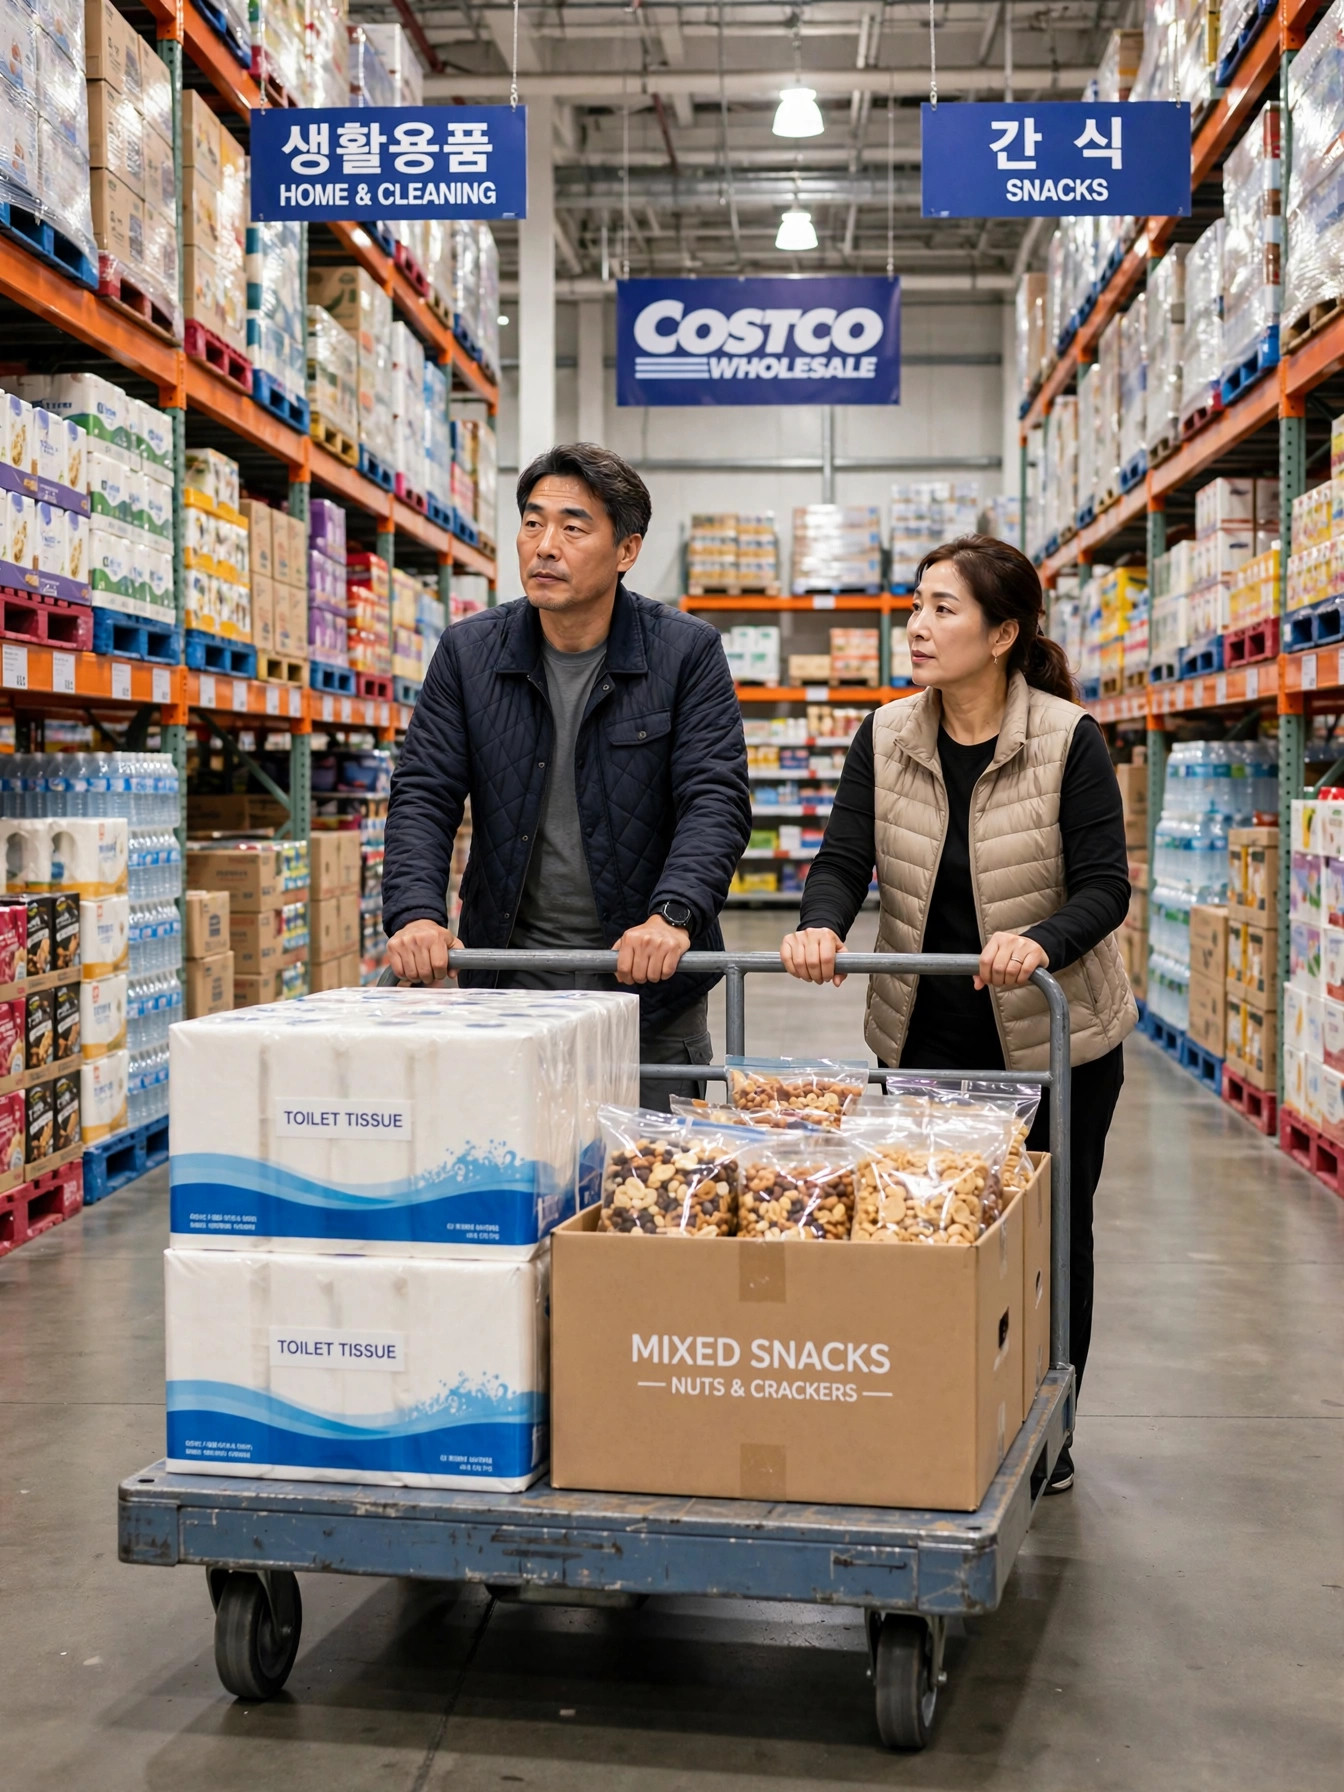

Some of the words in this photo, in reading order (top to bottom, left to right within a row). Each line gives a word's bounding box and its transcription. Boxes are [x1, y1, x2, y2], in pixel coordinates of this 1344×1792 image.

[281, 121, 493, 176] 생활용품
[280, 183, 349, 207] HOME
[356, 183, 372, 206] &
[377, 181, 497, 206] CLEANING
[1006, 178, 1109, 202] SNACKS
[633, 299, 884, 355] COSTCO
[709, 356, 878, 379] WHOLESALE
[283, 1110, 340, 1127] TOILET
[345, 1112, 403, 1128] TISSUE
[277, 1339, 334, 1356] TOILET
[338, 1342, 397, 1359] TISSUE
[631, 1333, 741, 1367] MIXED
[750, 1338, 891, 1374] SNACKS
[671, 1376, 725, 1396] NUTS
[730, 1378, 745, 1397] &
[750, 1379, 858, 1402] CRACKERS
